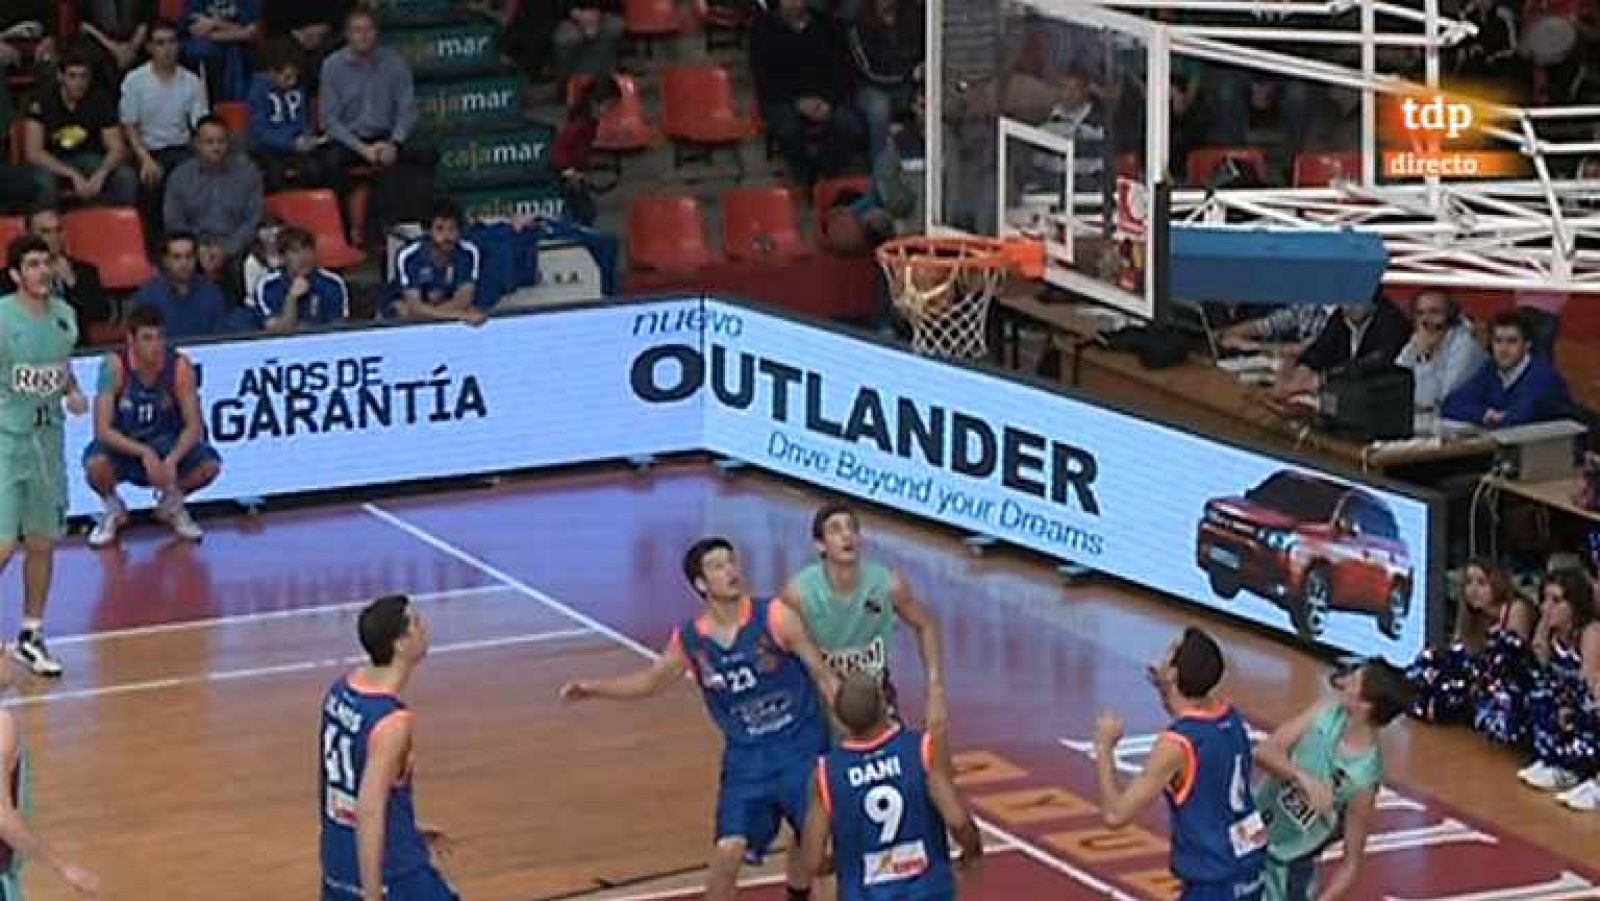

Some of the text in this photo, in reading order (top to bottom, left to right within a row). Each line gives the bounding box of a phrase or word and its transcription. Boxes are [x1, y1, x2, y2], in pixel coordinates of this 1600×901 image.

[440, 141, 545, 171] cajamar
[632, 305, 744, 337] nuevo
[238, 355, 384, 398] AÑOS DE
[211, 364, 487, 442] GARANTÍA
[630, 343, 1100, 515] OUTLANDER
[768, 431, 1104, 556] Drive Beyond your Dreams
[726, 666, 758, 693] 23
[848, 755, 900, 787] DANI
[864, 785, 904, 843] 9
